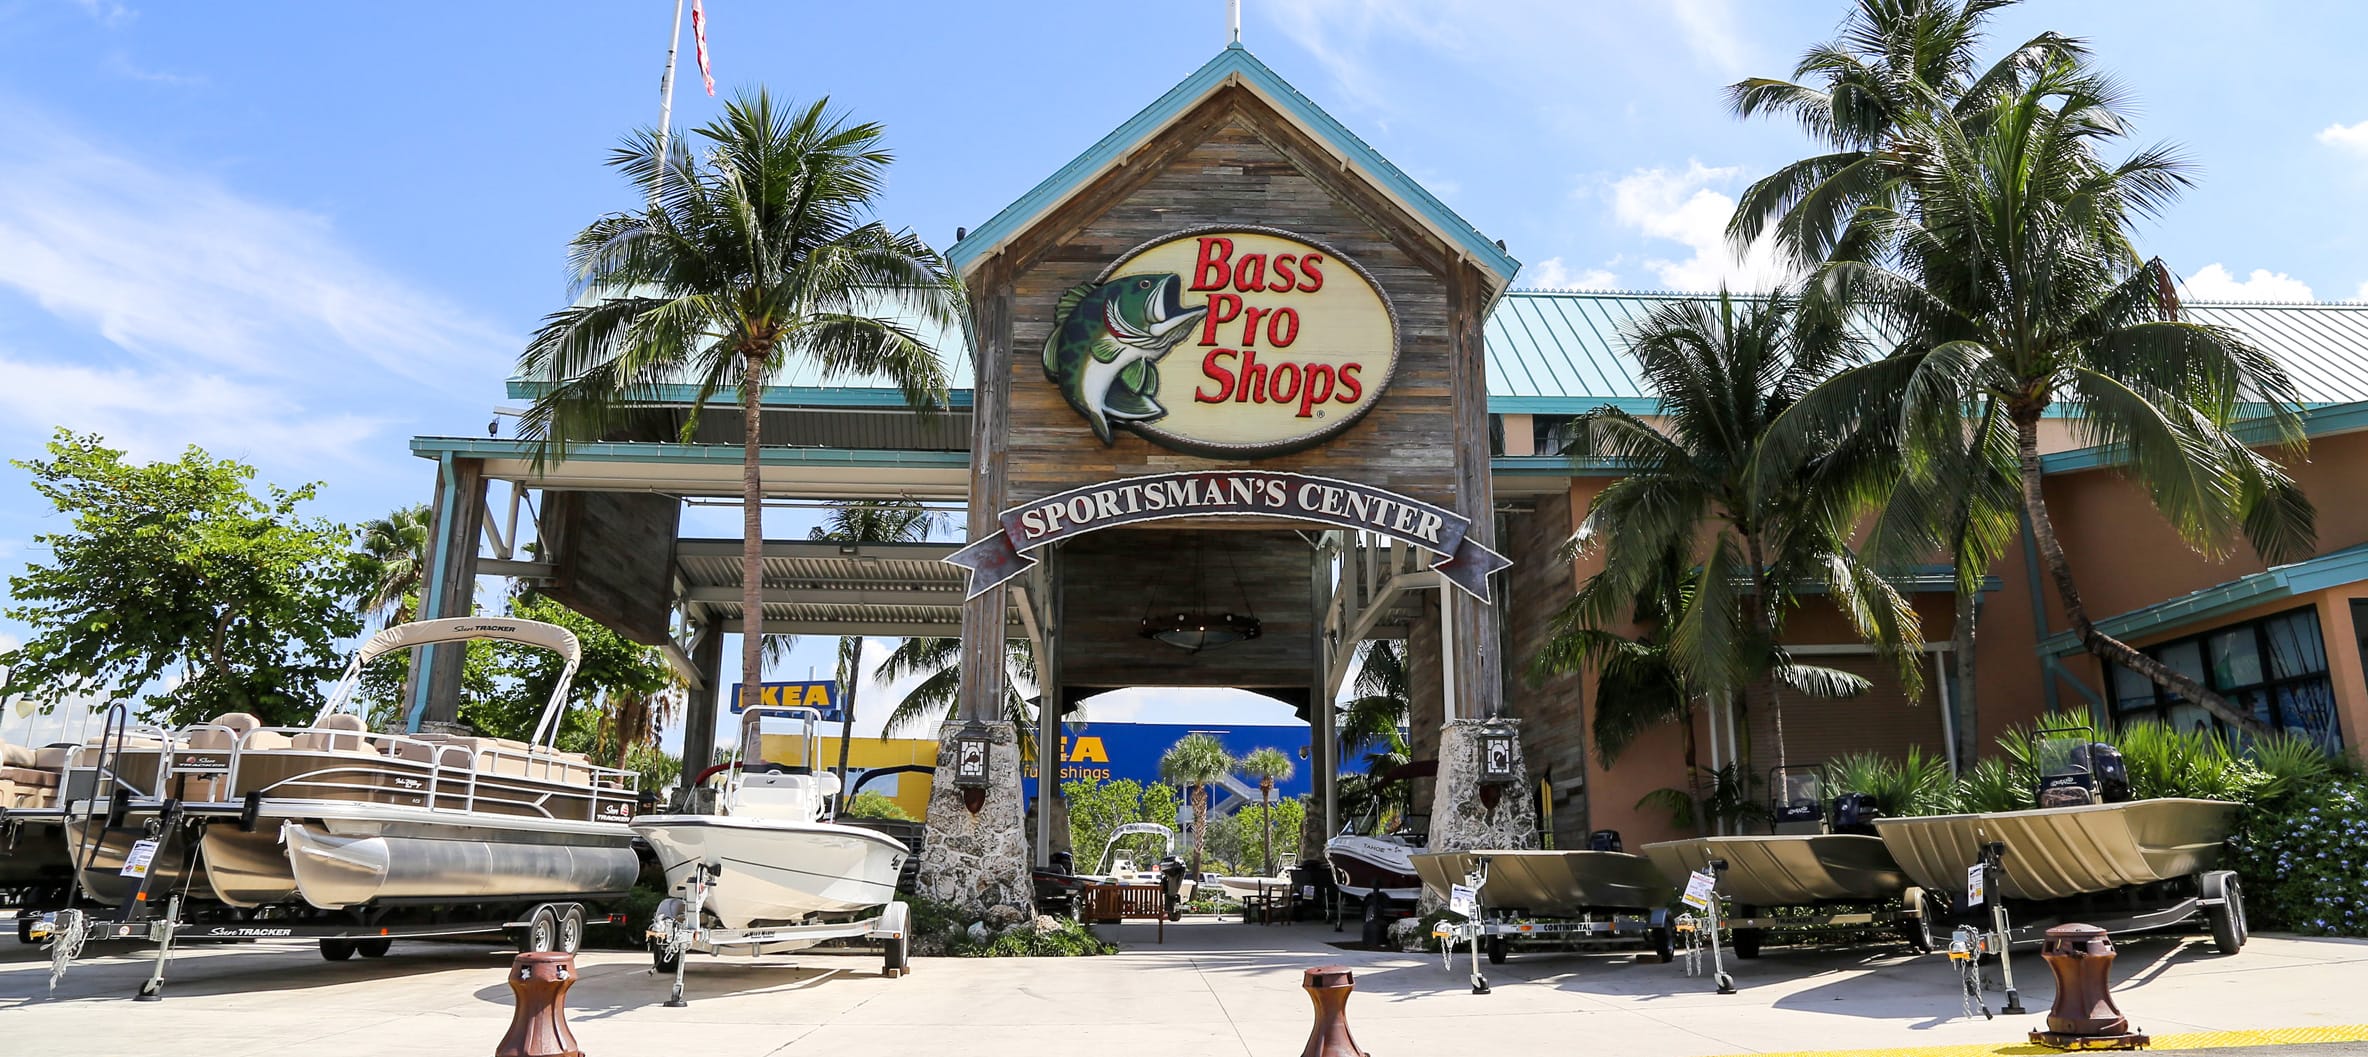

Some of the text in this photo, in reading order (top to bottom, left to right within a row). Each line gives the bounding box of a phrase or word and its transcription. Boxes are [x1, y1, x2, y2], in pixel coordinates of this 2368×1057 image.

[1188, 237, 1324, 293] Bass
[1198, 293, 1300, 348] Pro
[1194, 347, 1363, 418] Shops
[1021, 478, 1443, 545] SPORTSMAN'S CENTER
[596, 814, 631, 823] TRACKER
[1363, 843, 1386, 853] TAHOE
[207, 927, 292, 936] Sun TRACKER
